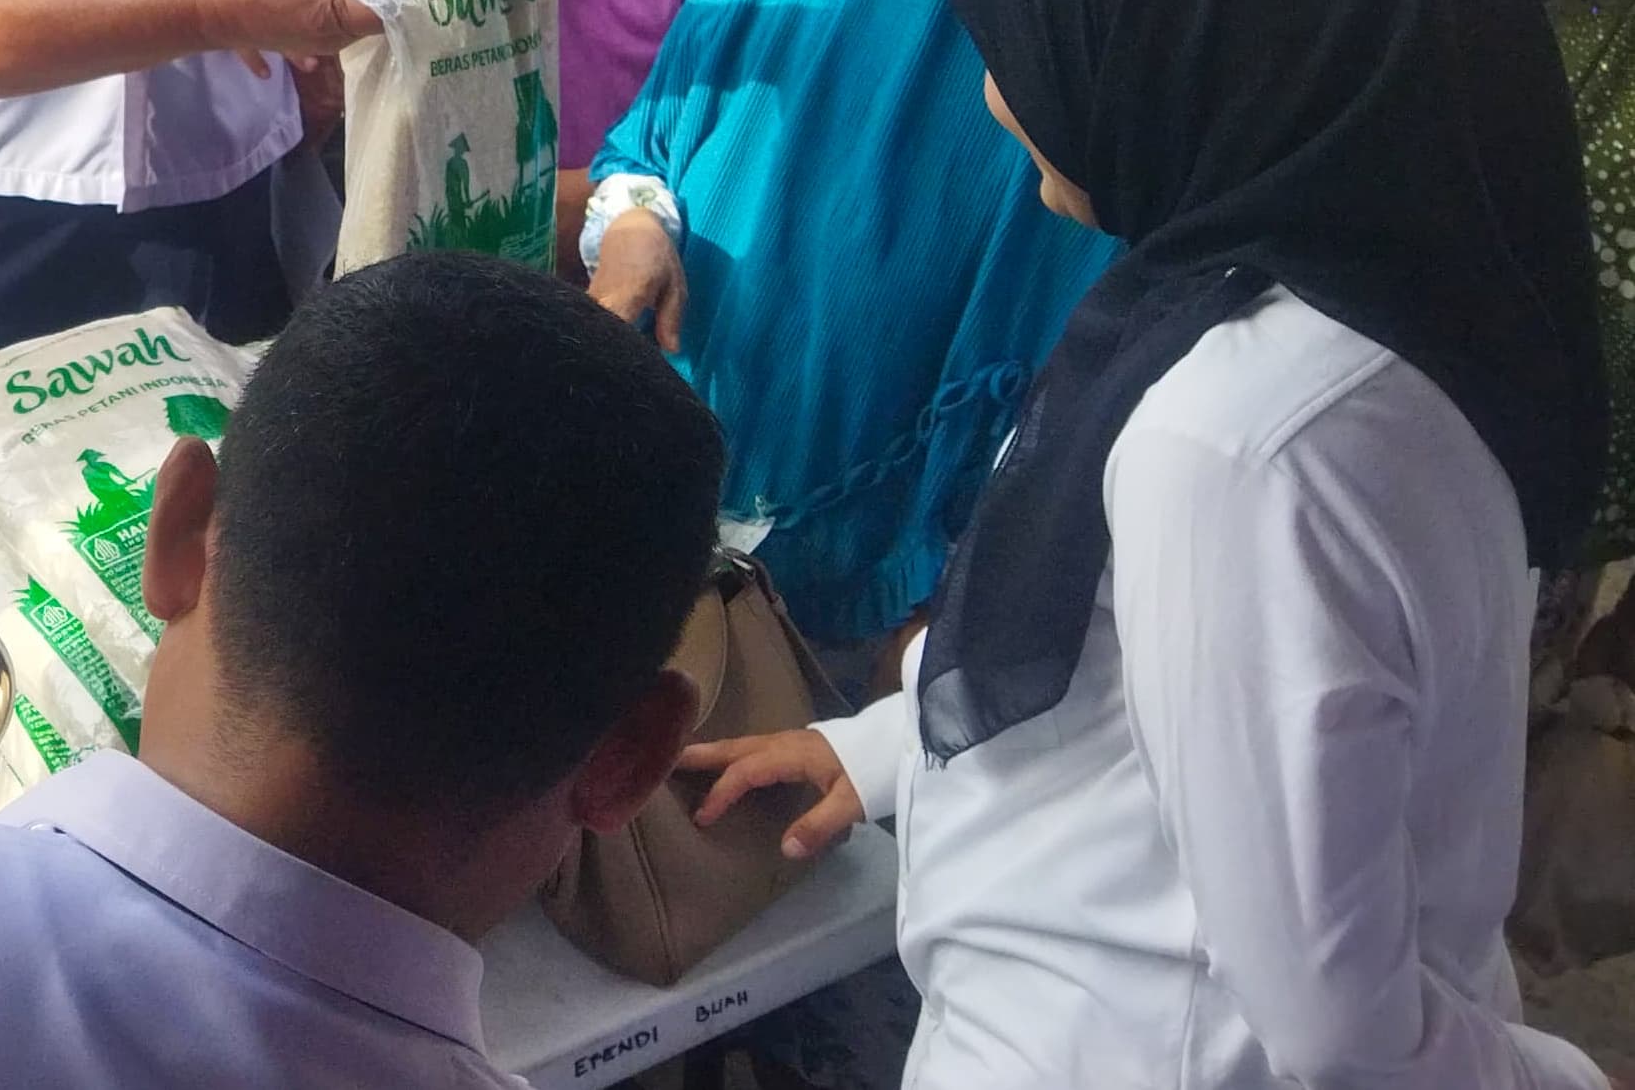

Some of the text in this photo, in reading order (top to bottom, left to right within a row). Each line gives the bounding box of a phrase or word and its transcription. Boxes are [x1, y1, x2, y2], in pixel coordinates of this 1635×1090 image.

[430, 53, 471, 78] BERAS
[6, 327, 192, 415] Sawah
[78, 385, 140, 418] PETANI
[141, 375, 229, 393] INDONESIA
[695, 990, 748, 1023] BUAH
